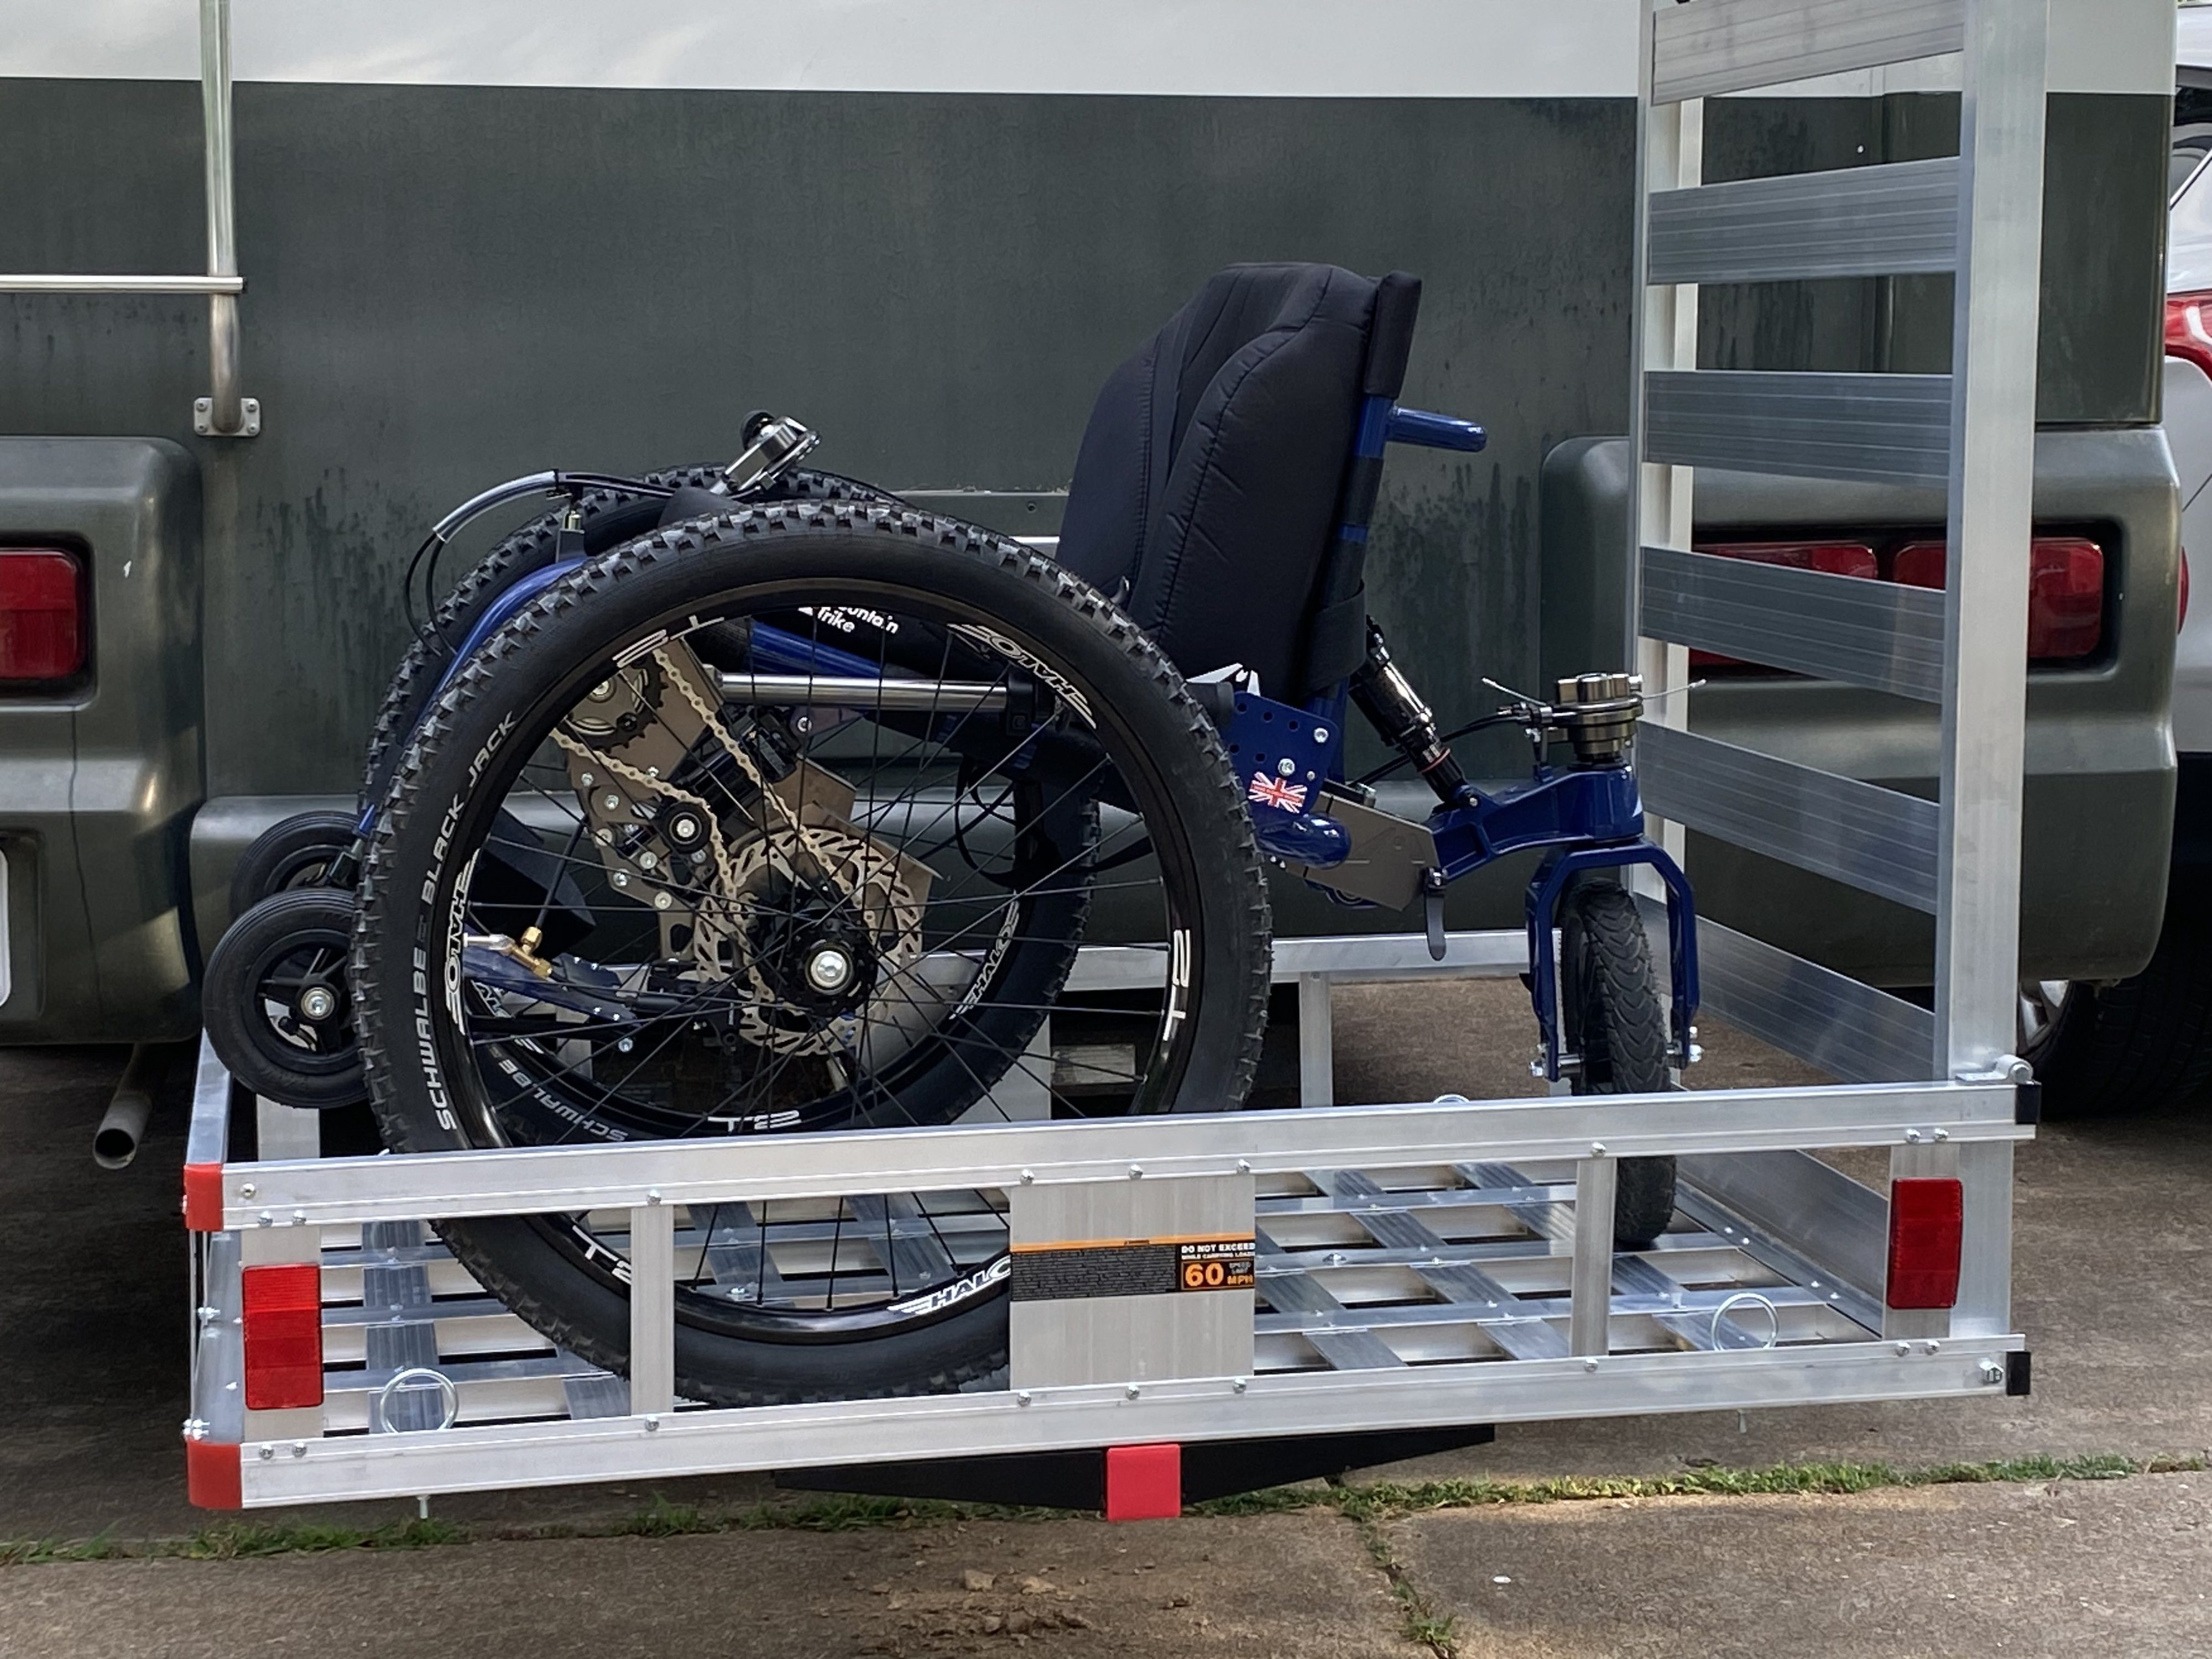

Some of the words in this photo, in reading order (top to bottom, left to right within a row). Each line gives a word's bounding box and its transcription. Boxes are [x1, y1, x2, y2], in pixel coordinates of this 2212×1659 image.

[817, 606, 855, 633] Trike
[468, 709, 517, 789] JACK
[421, 793, 465, 905] BLACK
[413, 946, 458, 1131] SCHWALBE
[498, 1058, 629, 1142] SCHWALBE
[1181, 1245, 1195, 1254] DO
[1197, 1244, 1217, 1253] NOT
[1218, 1242, 1256, 1251] EXCEED
[1185, 1262, 1224, 1287] 60
[1227, 1274, 1254, 1285] MPH
